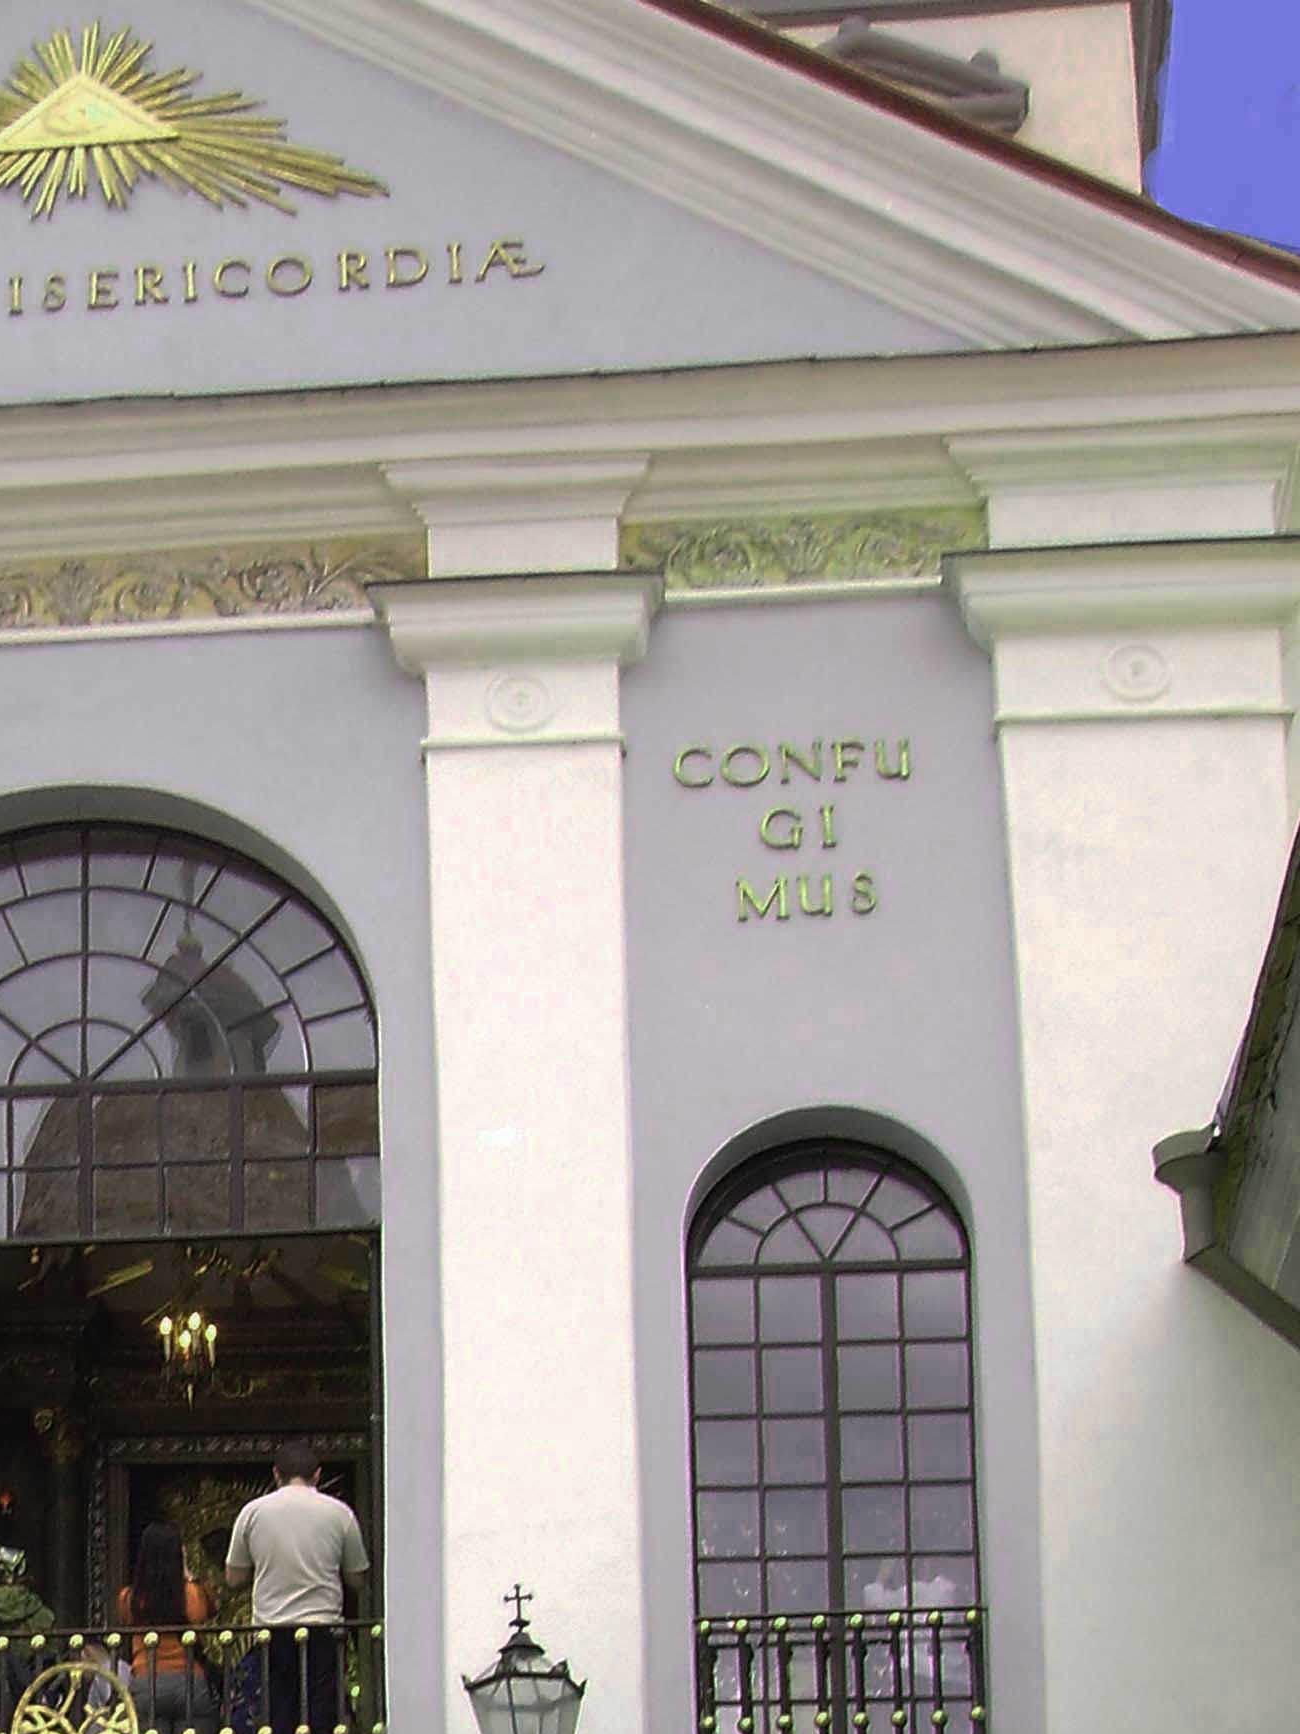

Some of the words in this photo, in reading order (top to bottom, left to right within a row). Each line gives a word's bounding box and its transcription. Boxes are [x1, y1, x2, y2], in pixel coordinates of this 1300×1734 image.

[672, 738, 913, 793] CONFU
[758, 804, 839, 856] GI
[735, 871, 879, 924] MUS
